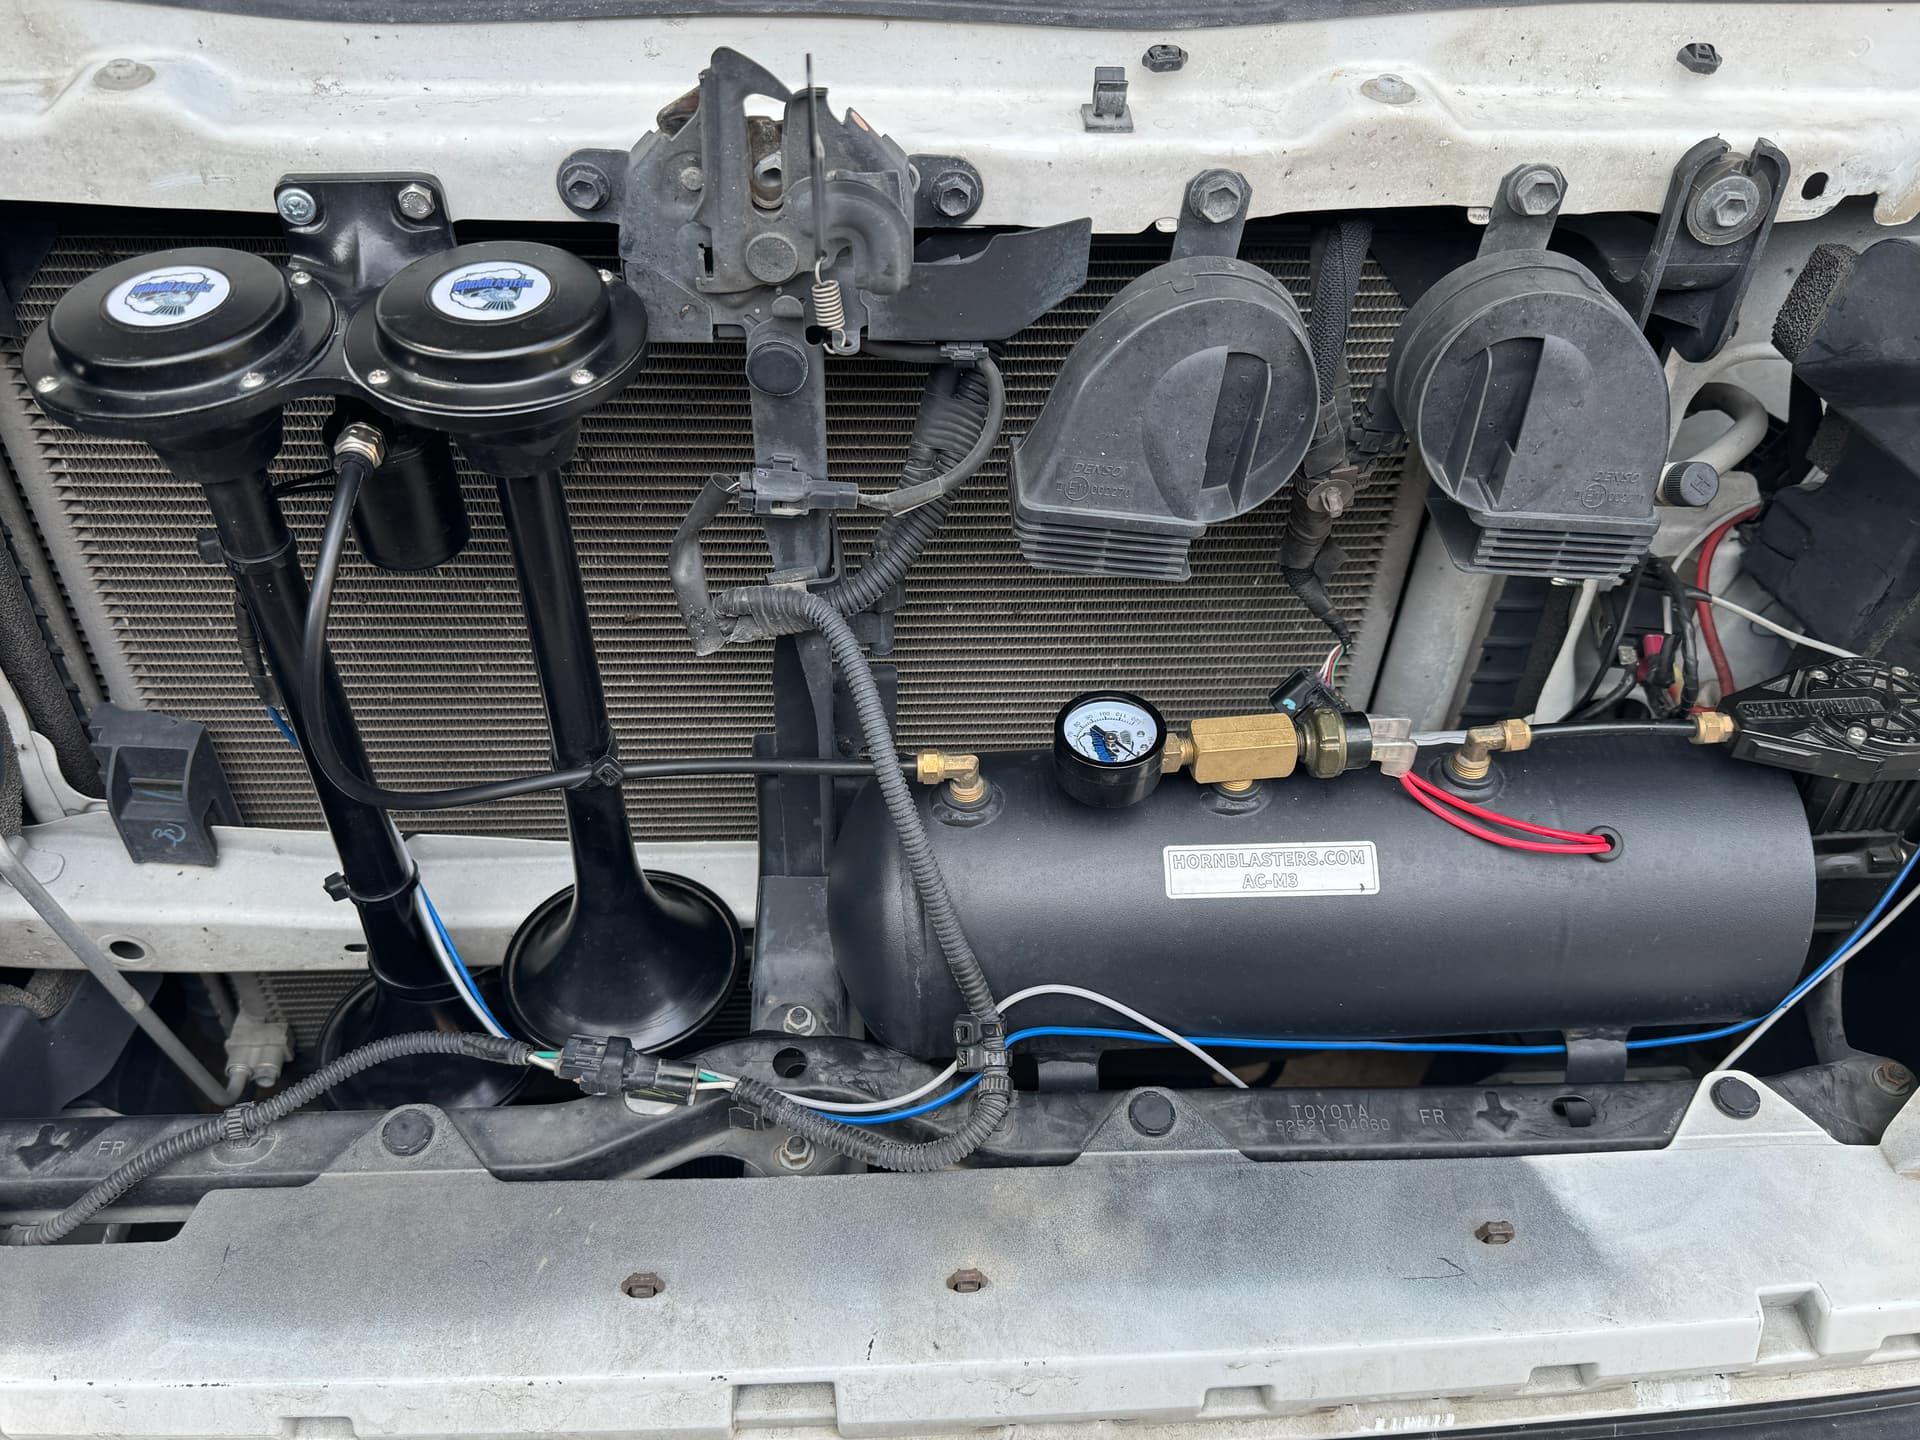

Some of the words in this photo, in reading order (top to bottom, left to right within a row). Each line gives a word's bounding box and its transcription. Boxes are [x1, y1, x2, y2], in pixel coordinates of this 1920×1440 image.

[1072, 462, 1122, 478] DENSO
[1172, 850, 1366, 869] HORNBLASTERS.COM
[1242, 873, 1299, 889] AC-M3
[1291, 1104, 1369, 1120] TOYOTA
[1419, 1109, 1446, 1125] FR
[1275, 1118, 1391, 1133] 52521-04060
[96, 1140, 125, 1156] FR
